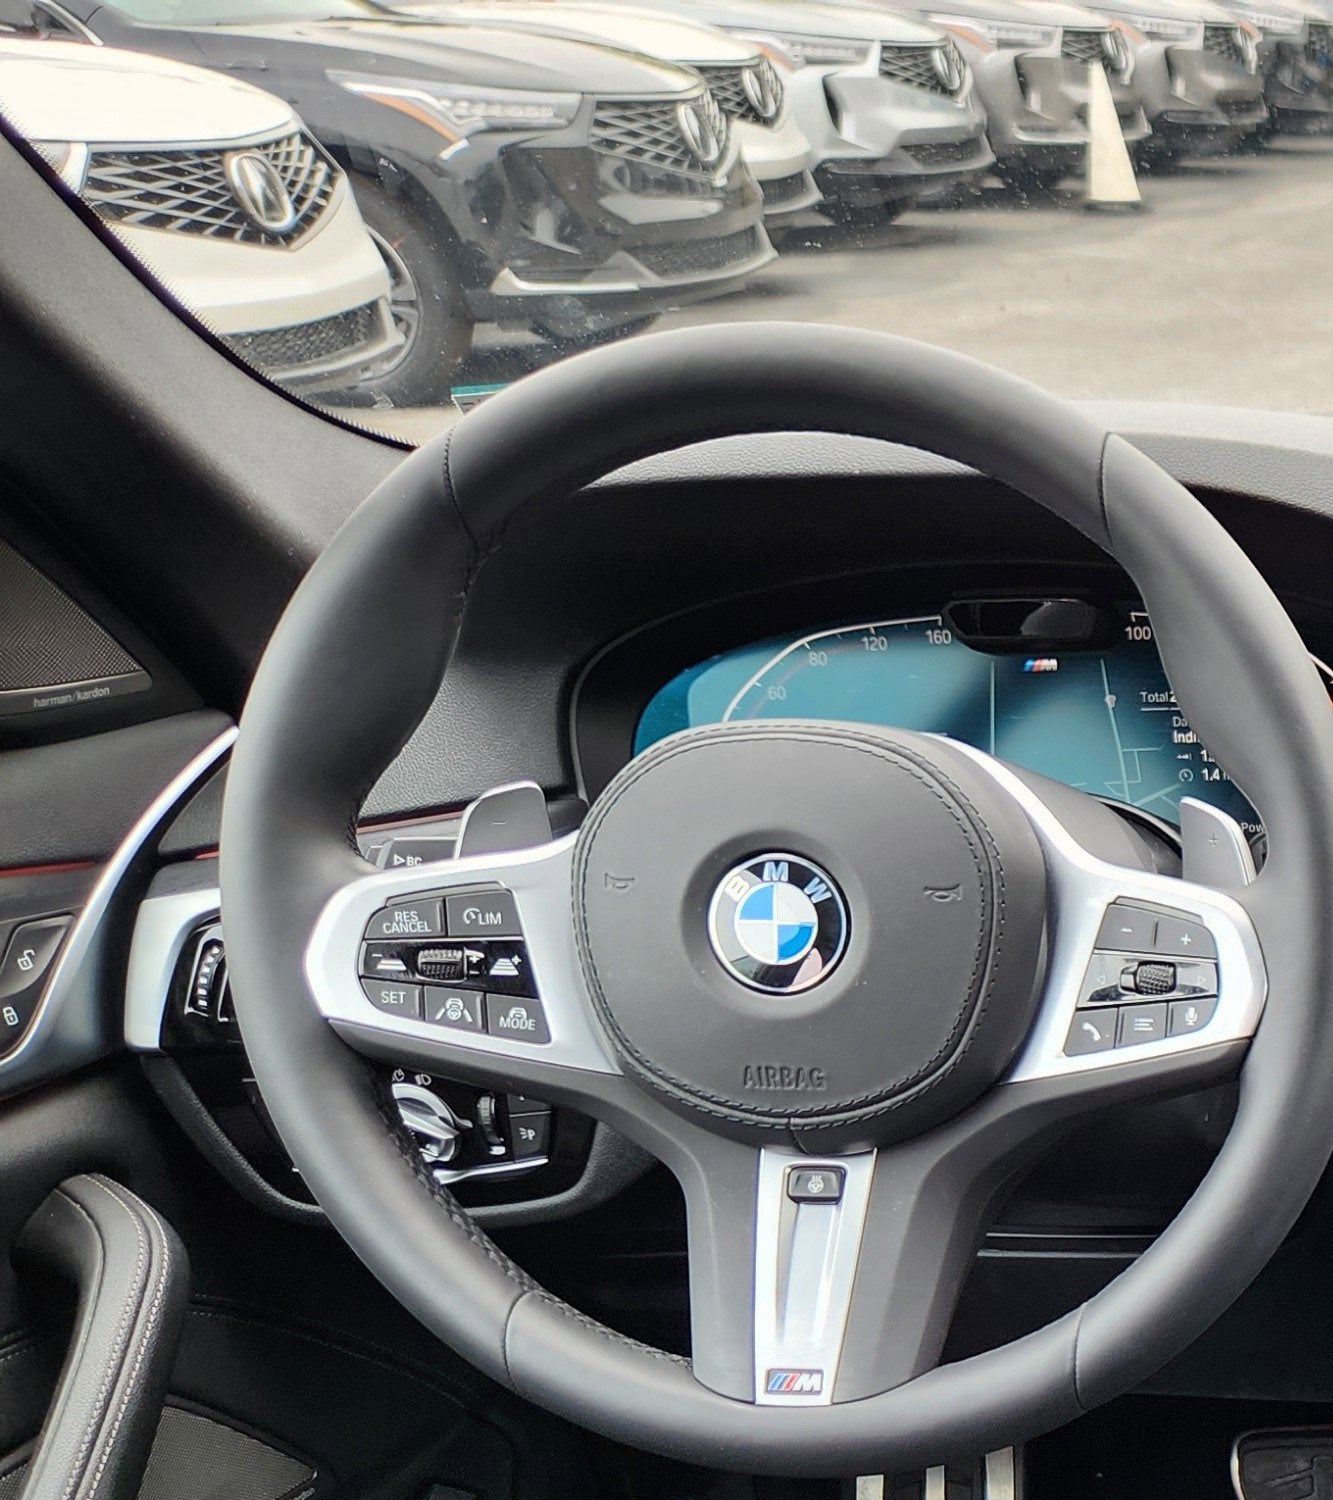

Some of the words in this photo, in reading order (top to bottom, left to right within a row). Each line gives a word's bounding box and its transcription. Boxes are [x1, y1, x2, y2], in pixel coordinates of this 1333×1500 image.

[926, 629, 952, 645] 160
[1126, 626, 1151, 641] 100
[862, 636, 889, 652] 120
[809, 652, 828, 667] 80
[767, 686, 787, 701] 60
[1139, 691, 1169, 703] Total
[724, 861, 832, 904] BMW
[394, 910, 419, 922] RES
[478, 912, 502, 926] LIM
[382, 921, 432, 935] CANCEL
[381, 991, 407, 1004] SET
[500, 1017, 536, 1031] MODE
[743, 1064, 827, 1091] AIRBAG
